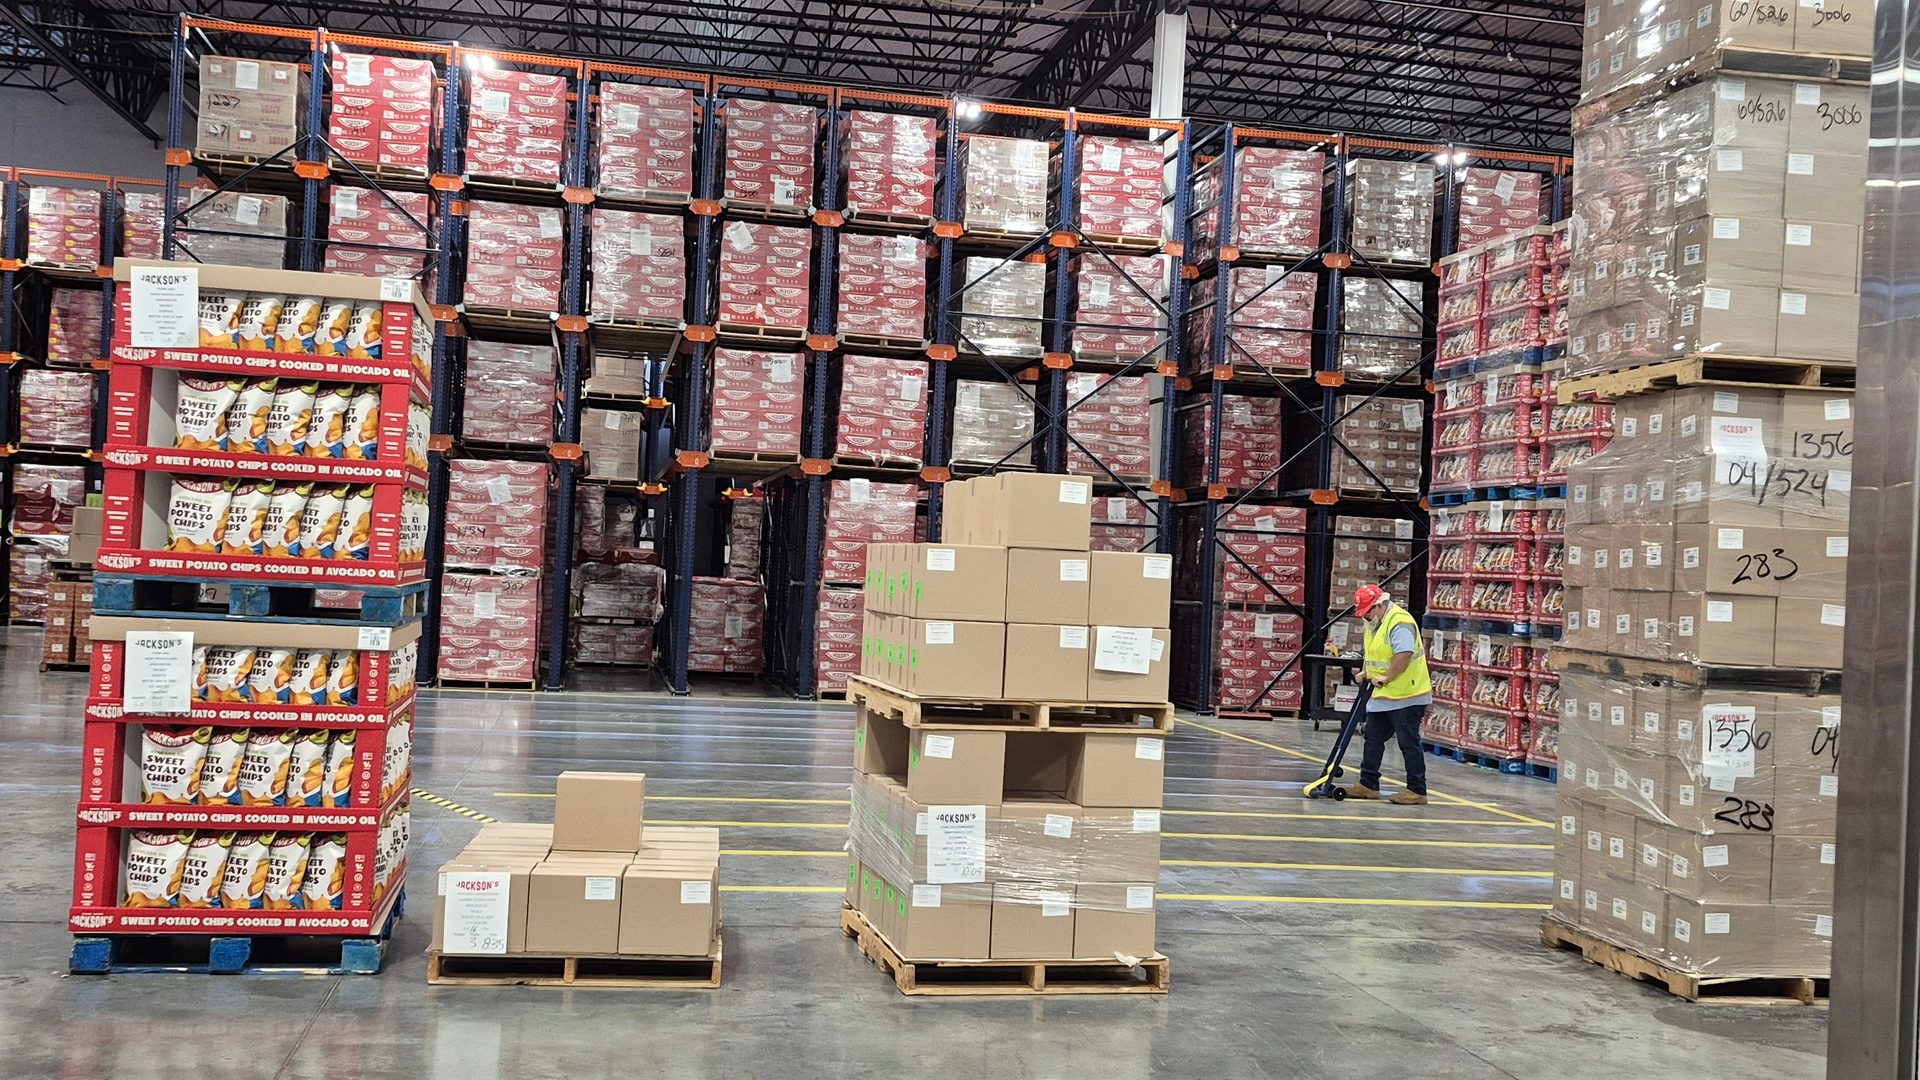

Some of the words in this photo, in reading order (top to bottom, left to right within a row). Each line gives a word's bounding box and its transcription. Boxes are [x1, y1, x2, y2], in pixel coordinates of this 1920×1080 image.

[1812, 3, 1851, 28] 3006
[1817, 103, 1862, 131] 3006
[140, 274, 188, 285] JACKSON'S
[199, 295, 226, 304] WEET
[199, 304, 229, 313] TATO
[199, 311, 222, 322] HIPS
[113, 347, 157, 361] JACKSON'S
[164, 351, 199, 362] SWEET
[201, 355, 243, 365] POTATO
[245, 358, 277, 368] CHIPS
[279, 360, 324, 371] COOKED
[326, 364, 338, 372] IN
[340, 365, 391, 376] AVOCADO
[392, 369, 411, 378] OIL
[181, 398, 218, 410] SWEET
[181, 416, 208, 427] CHIPS
[1793, 431, 1853, 460] 1356
[105, 452, 149, 466] JACKSON'S
[155, 455, 190, 466] SWEET
[193, 458, 235, 468] POTATO
[237, 460, 269, 470] CHIPS
[271, 462, 316, 474] COOKED
[318, 465, 330, 474] IN
[332, 466, 382, 477] AVOCADO
[385, 468, 403, 478] OIL
[1729, 460, 1829, 507] 04/524
[175, 500, 213, 513] SWEET
[229, 506, 247, 514] EET
[171, 509, 213, 521] POTATO
[174, 518, 205, 529] CHIPS
[98, 555, 142, 569] JACKSON'S
[1731, 548, 1799, 585] 283
[149, 558, 184, 569] SWEET
[186, 561, 228, 571] POTATO
[230, 563, 262, 572] CHIPS
[264, 565, 309, 575] COOKED
[312, 566, 324, 575] IN
[325, 567, 376, 578] AVOCADO
[378, 569, 396, 579] OIL
[135, 639, 182, 650] JACKSON'S
[206, 649, 235, 659] WEET
[206, 659, 236, 667] OTATO
[87, 705, 124, 719] JACKSON
[219, 709, 250, 720] CHIPS
[253, 711, 299, 721] COOKED
[301, 712, 312, 721] IN
[314, 712, 365, 723] AVOCADO
[367, 714, 385, 723] OIL
[1708, 719, 1771, 753] 1356
[147, 755, 185, 766] SWEET
[244, 755, 269, 764] WEET
[143, 763, 186, 775] POTATO
[240, 764, 271, 773] OTATO
[147, 773, 179, 784] CHIPS
[78, 809, 122, 823] JACKSON'S
[128, 811, 164, 822] SWEET
[166, 812, 208, 822] POTATO
[210, 812, 242, 822] CHIPS
[245, 814, 290, 824] COOKED
[292, 814, 304, 824] IN
[306, 814, 357, 825] AVOCADO
[359, 816, 377, 825] OIL
[936, 813, 977, 823] JACKSON'S
[1714, 796, 1774, 831] 283
[131, 854, 167, 866] SWEET
[128, 863, 167, 875] POTATO
[130, 873, 159, 883] CHIPS
[456, 881, 499, 891] JACKSON'S
[70, 914, 115, 928] JACKSON'S
[120, 916, 156, 926] SWEET
[158, 916, 200, 926] POTATO
[203, 917, 234, 926] CHIPS
[237, 917, 282, 927] COOKED
[284, 917, 296, 927] IN
[299, 918, 349, 927] AVOCADO
[351, 918, 369, 928] OIL
